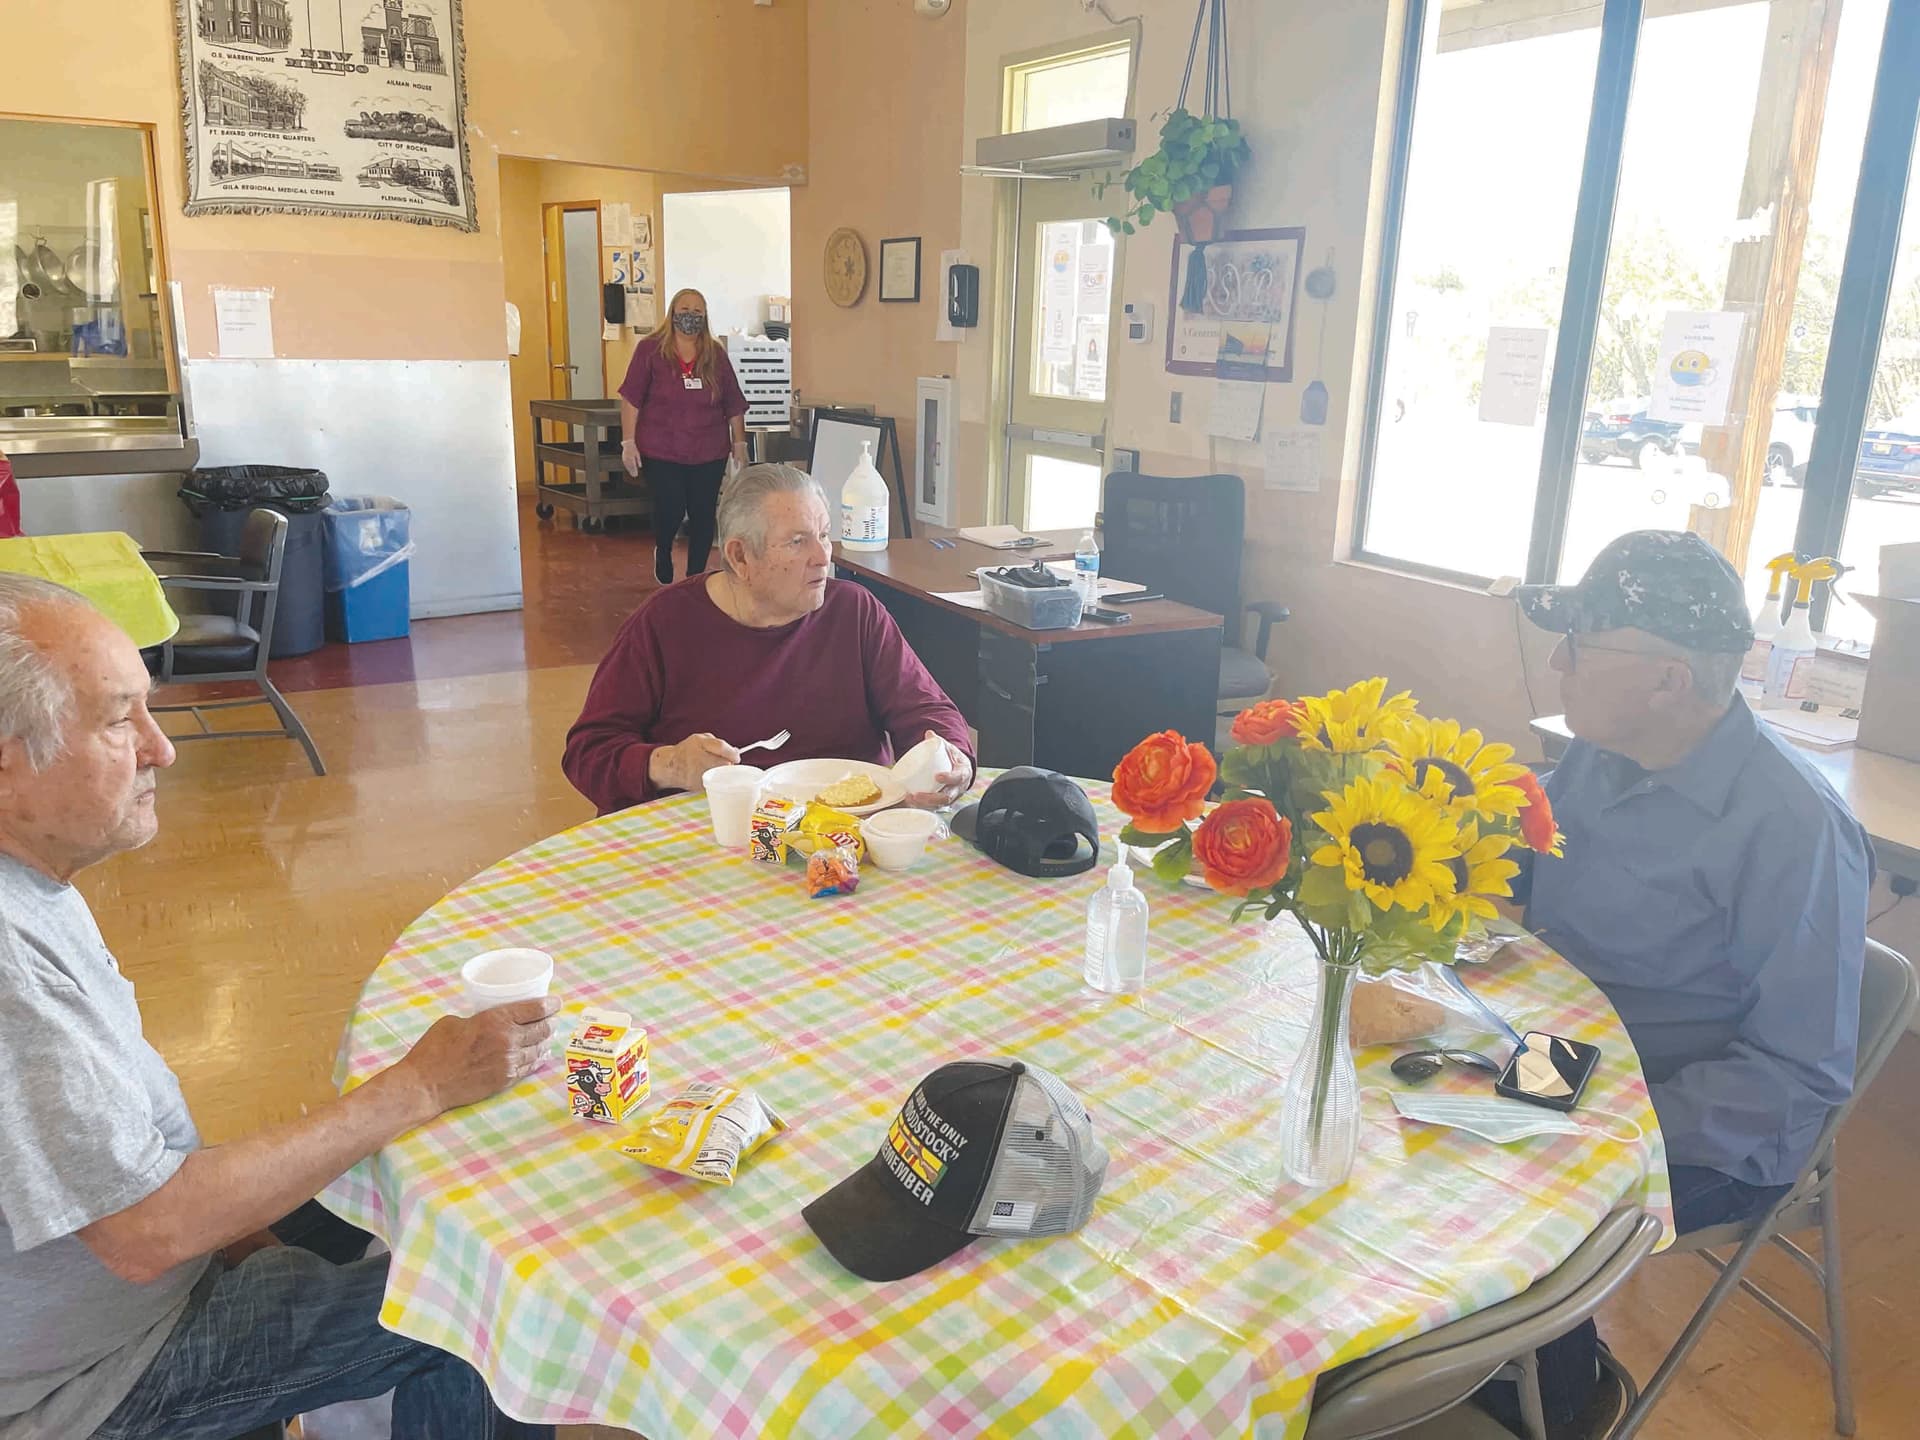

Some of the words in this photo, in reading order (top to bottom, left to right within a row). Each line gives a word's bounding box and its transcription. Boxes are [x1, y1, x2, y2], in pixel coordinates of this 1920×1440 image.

[226, 53, 254, 61] WARREN
[300, 48, 353, 62] NEW
[284, 57, 369, 74] MEXICO
[412, 83, 432, 91] HOUSE
[220, 129, 246, 137] BAYARD
[248, 131, 280, 139] OFFICERS
[282, 134, 316, 142] QUARTERS
[405, 144, 428, 152] ROCKS
[241, 184, 275, 192] REGIONAL
[571, 1037, 583, 1046] 2%
[922, 1105, 943, 1129] THE
[939, 1121, 969, 1149] ONLY
